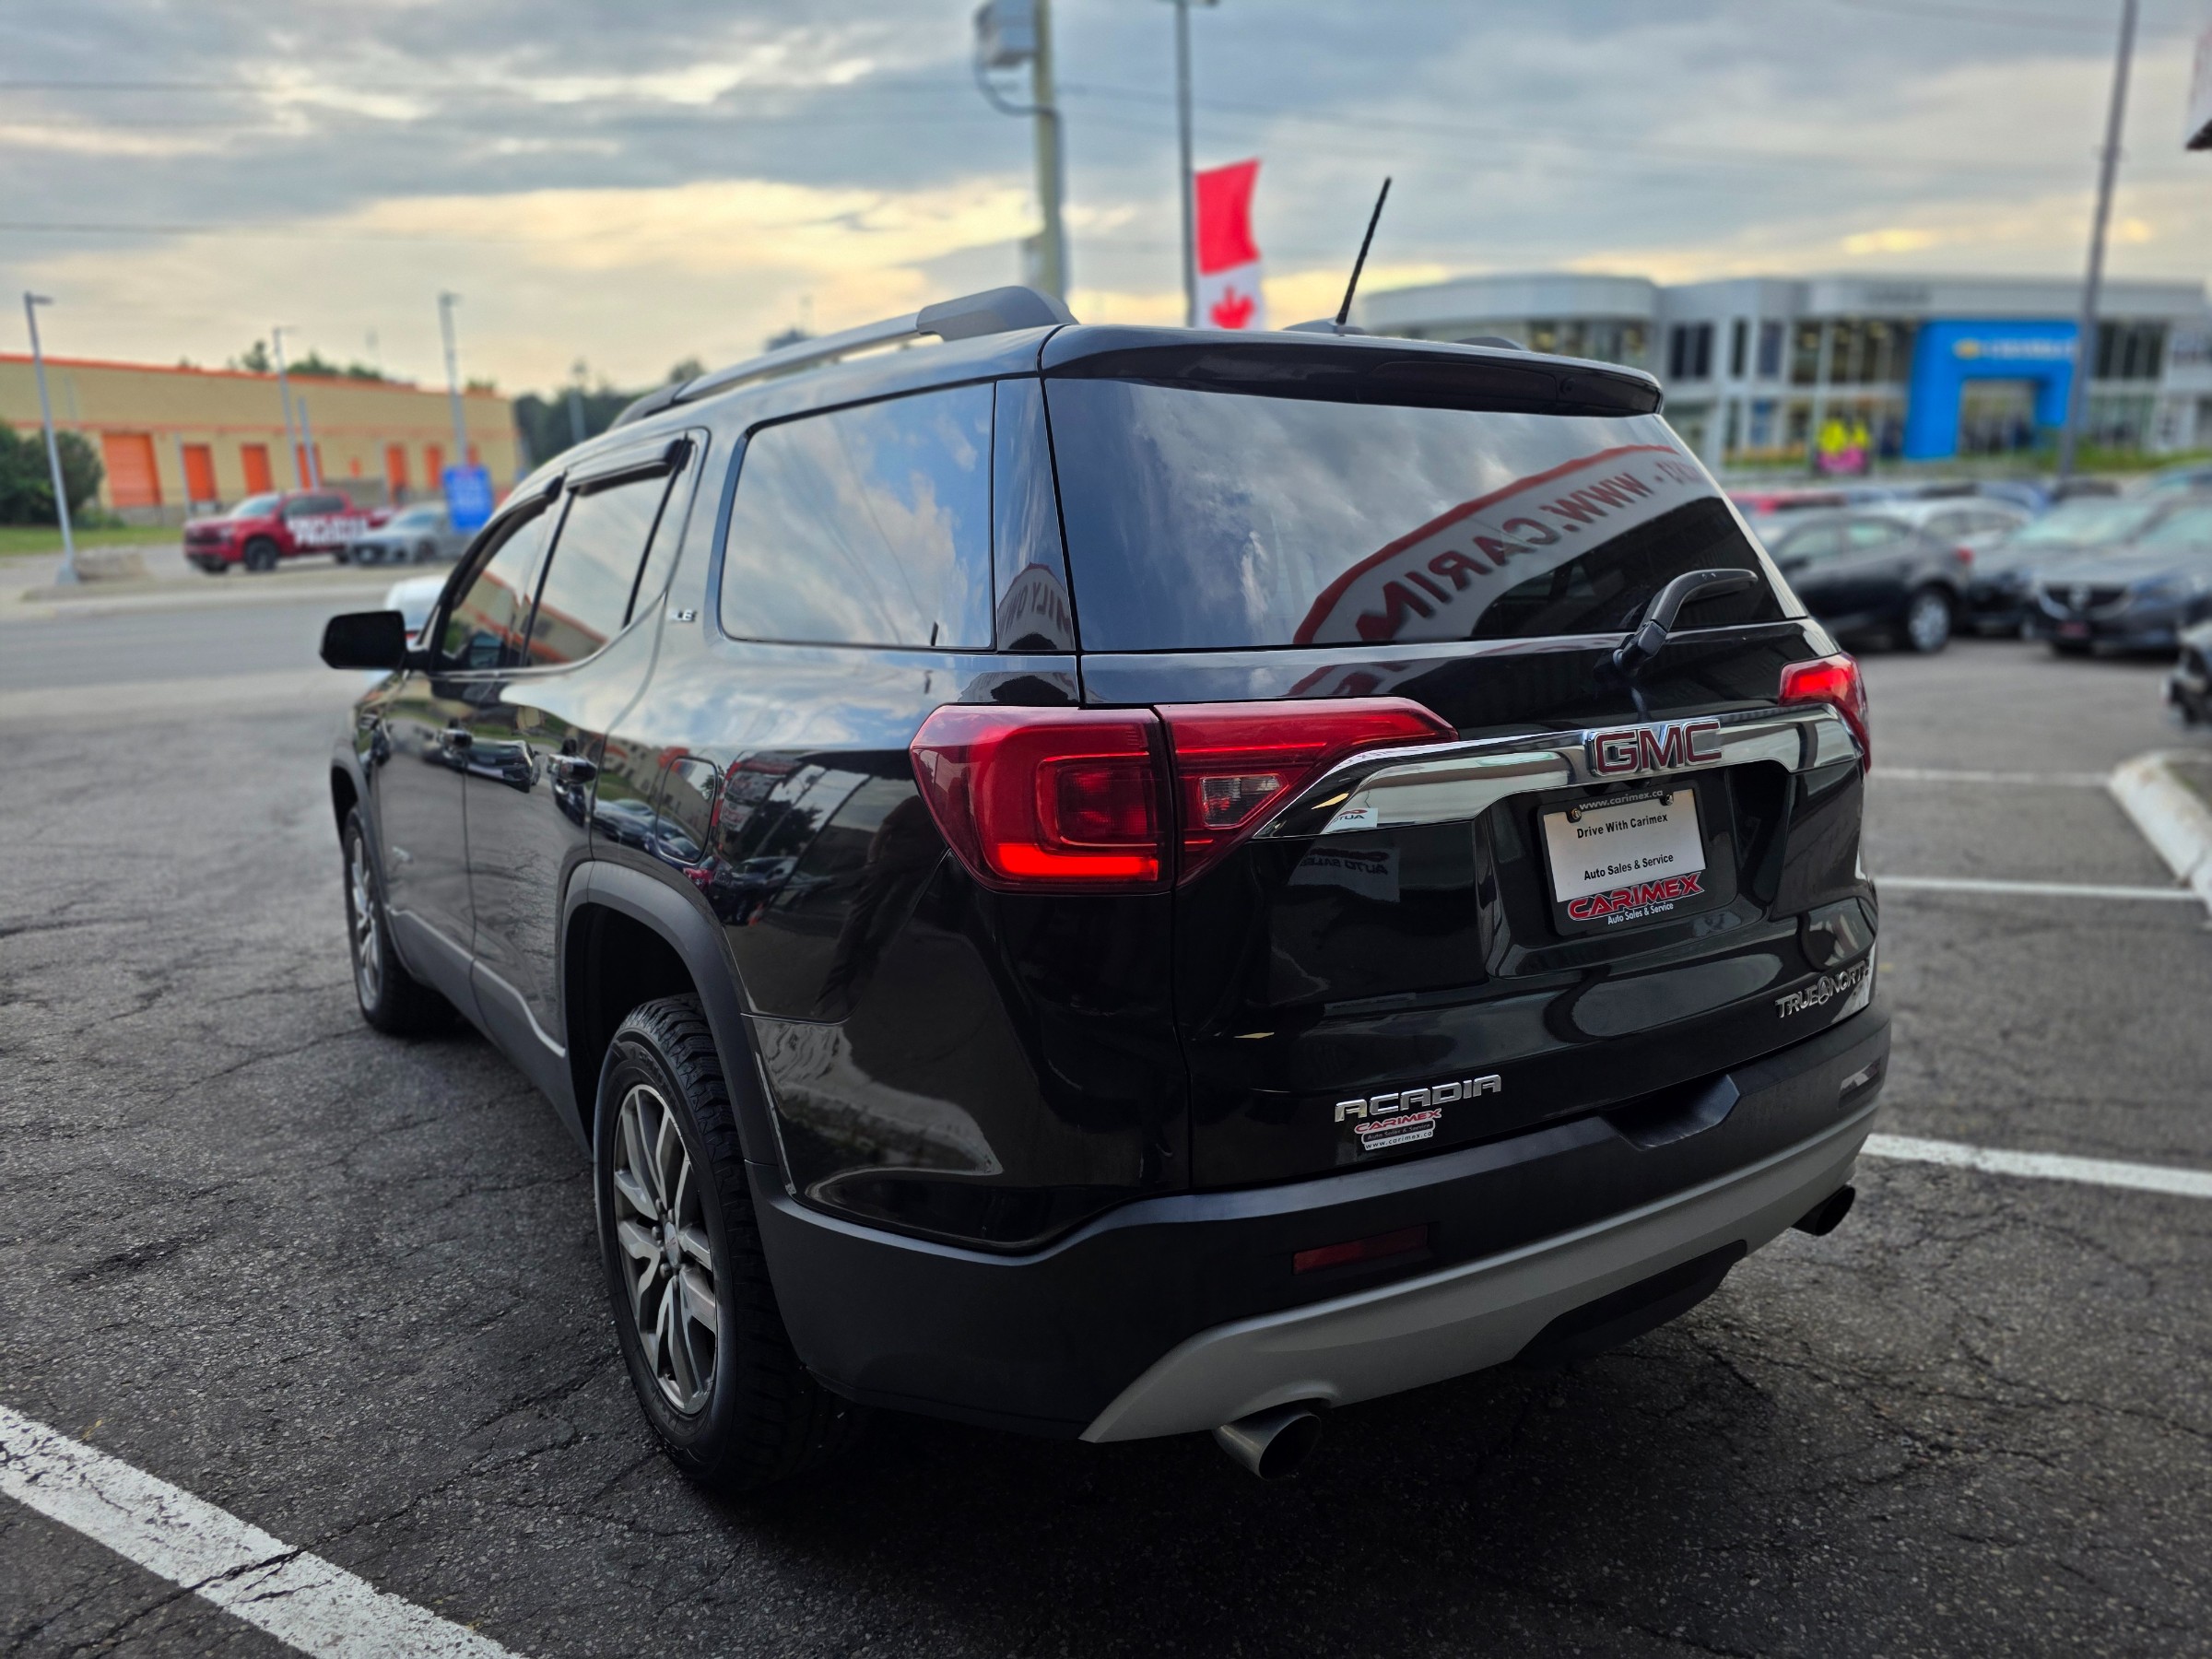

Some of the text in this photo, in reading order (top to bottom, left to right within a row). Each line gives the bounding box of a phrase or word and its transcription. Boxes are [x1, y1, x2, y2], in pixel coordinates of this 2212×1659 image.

[1588, 720, 1723, 776] GMC
[1578, 789, 1664, 811] www.carimex.ca
[1577, 814, 1668, 839] Drive With Carimex
[1583, 853, 1674, 881] Auto Sales & Service
[1568, 872, 1703, 920] CARIMEX
[1607, 913, 1624, 925] Auto
[1625, 908, 1643, 921] Sales
[1651, 902, 1674, 915] Service
[1774, 984, 1818, 1018] TRUE
[1335, 1074, 1502, 1122] ACADIA
[1355, 1109, 1441, 1133] CARIMEX
[1365, 1132, 1432, 1149] www.carimex.ca
